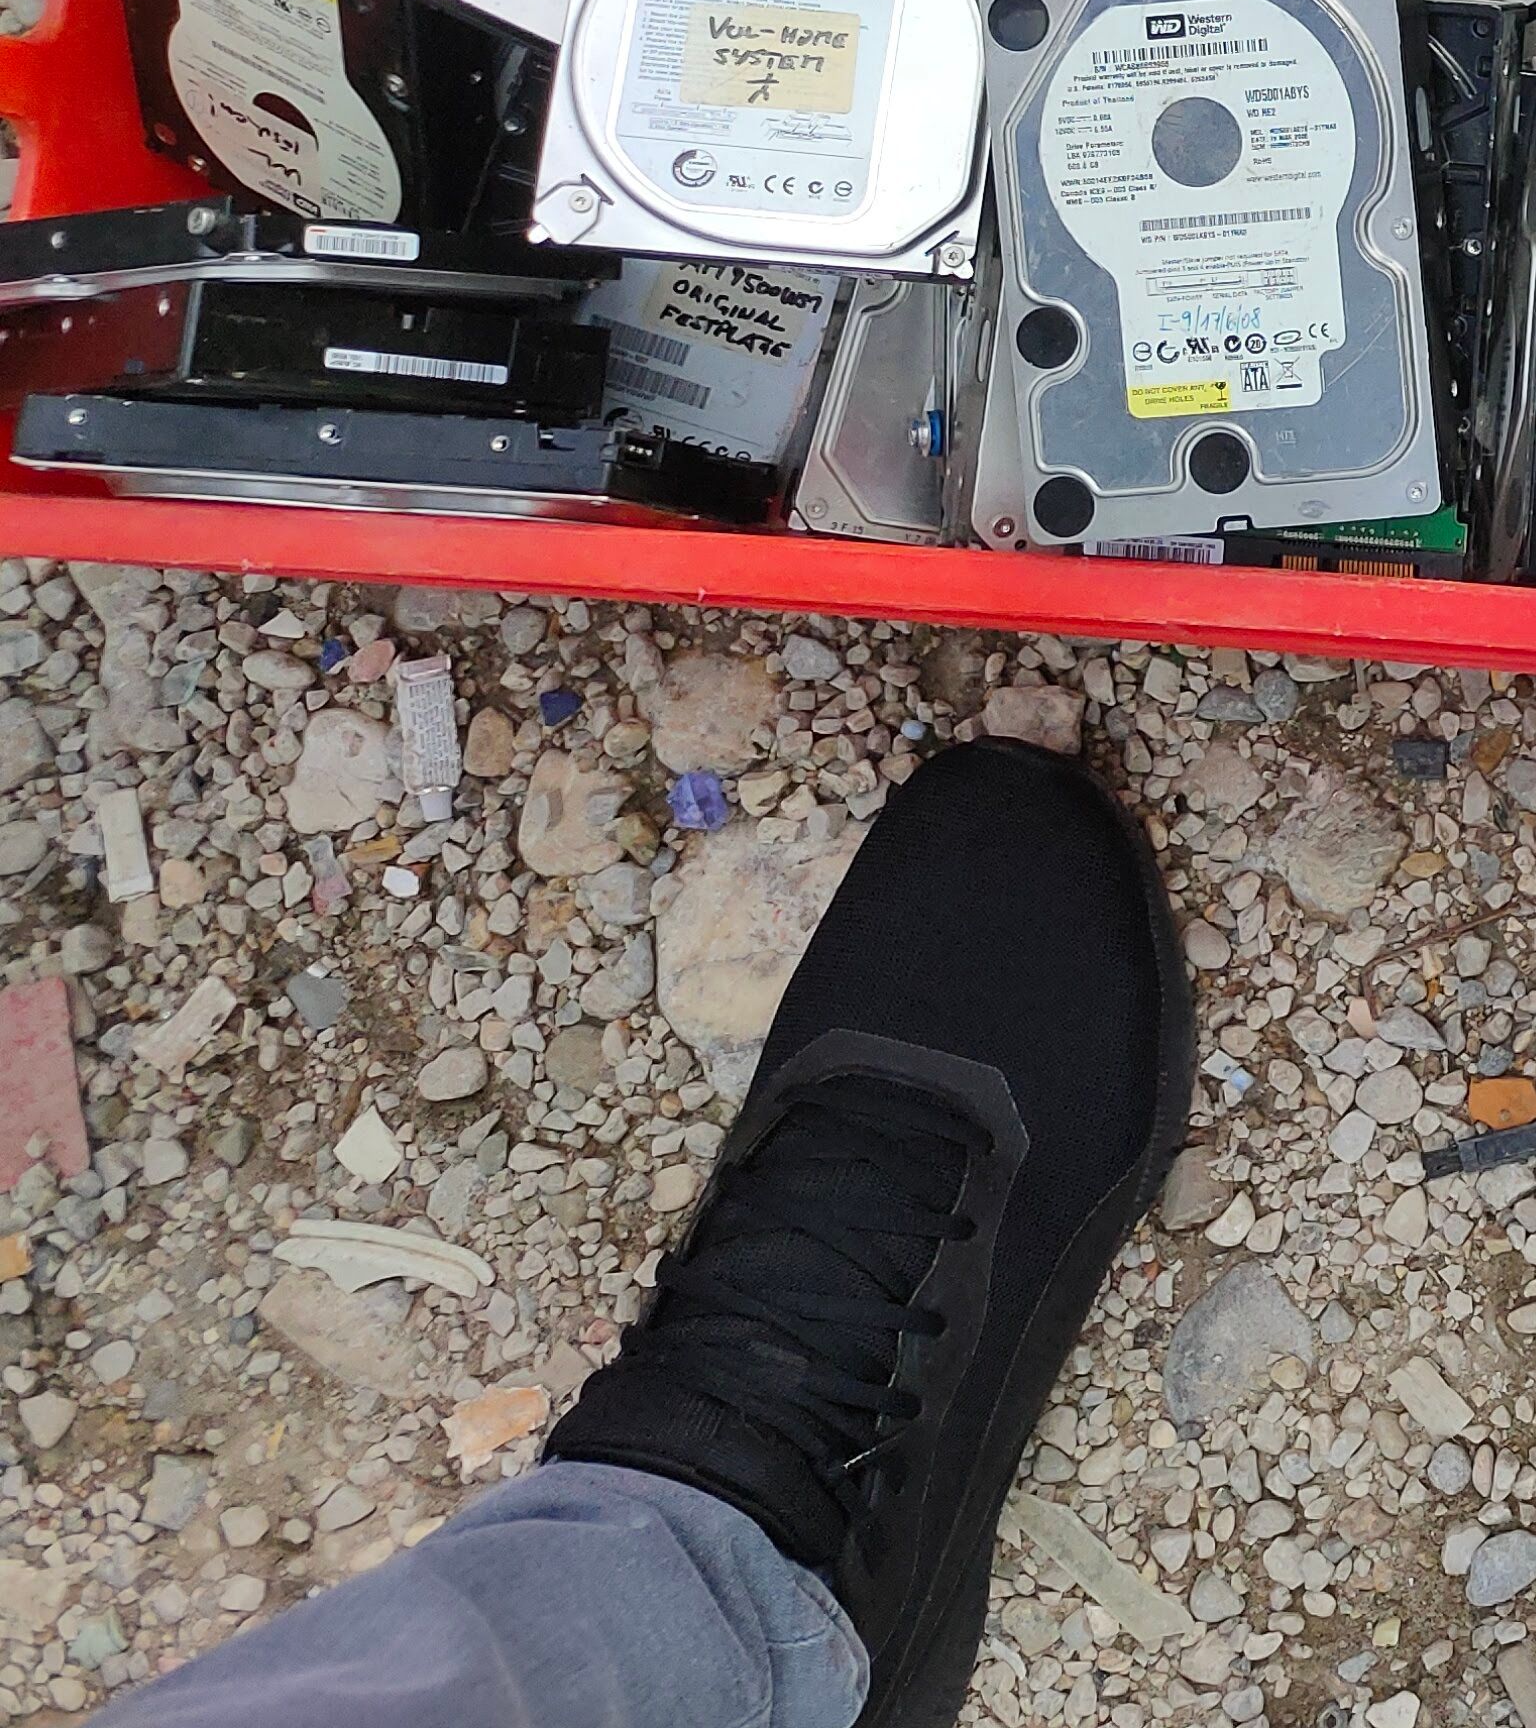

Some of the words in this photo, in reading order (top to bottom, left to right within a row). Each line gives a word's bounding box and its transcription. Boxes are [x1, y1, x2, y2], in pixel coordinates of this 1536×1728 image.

[1187, 13, 1232, 25] Western
[1149, 20, 1182, 38] WD
[1188, 23, 1223, 37] Digital
[763, 173, 796, 195] CE
[671, 276, 789, 333] ORIGINAL
[1308, 322, 1330, 338] CE
[1242, 367, 1271, 392] ATA
[1131, 388, 1143, 396] DO
[1160, 384, 1188, 394] COVER
[1168, 394, 1194, 404] HOLES
[1199, 401, 1227, 410] FRAGILE
